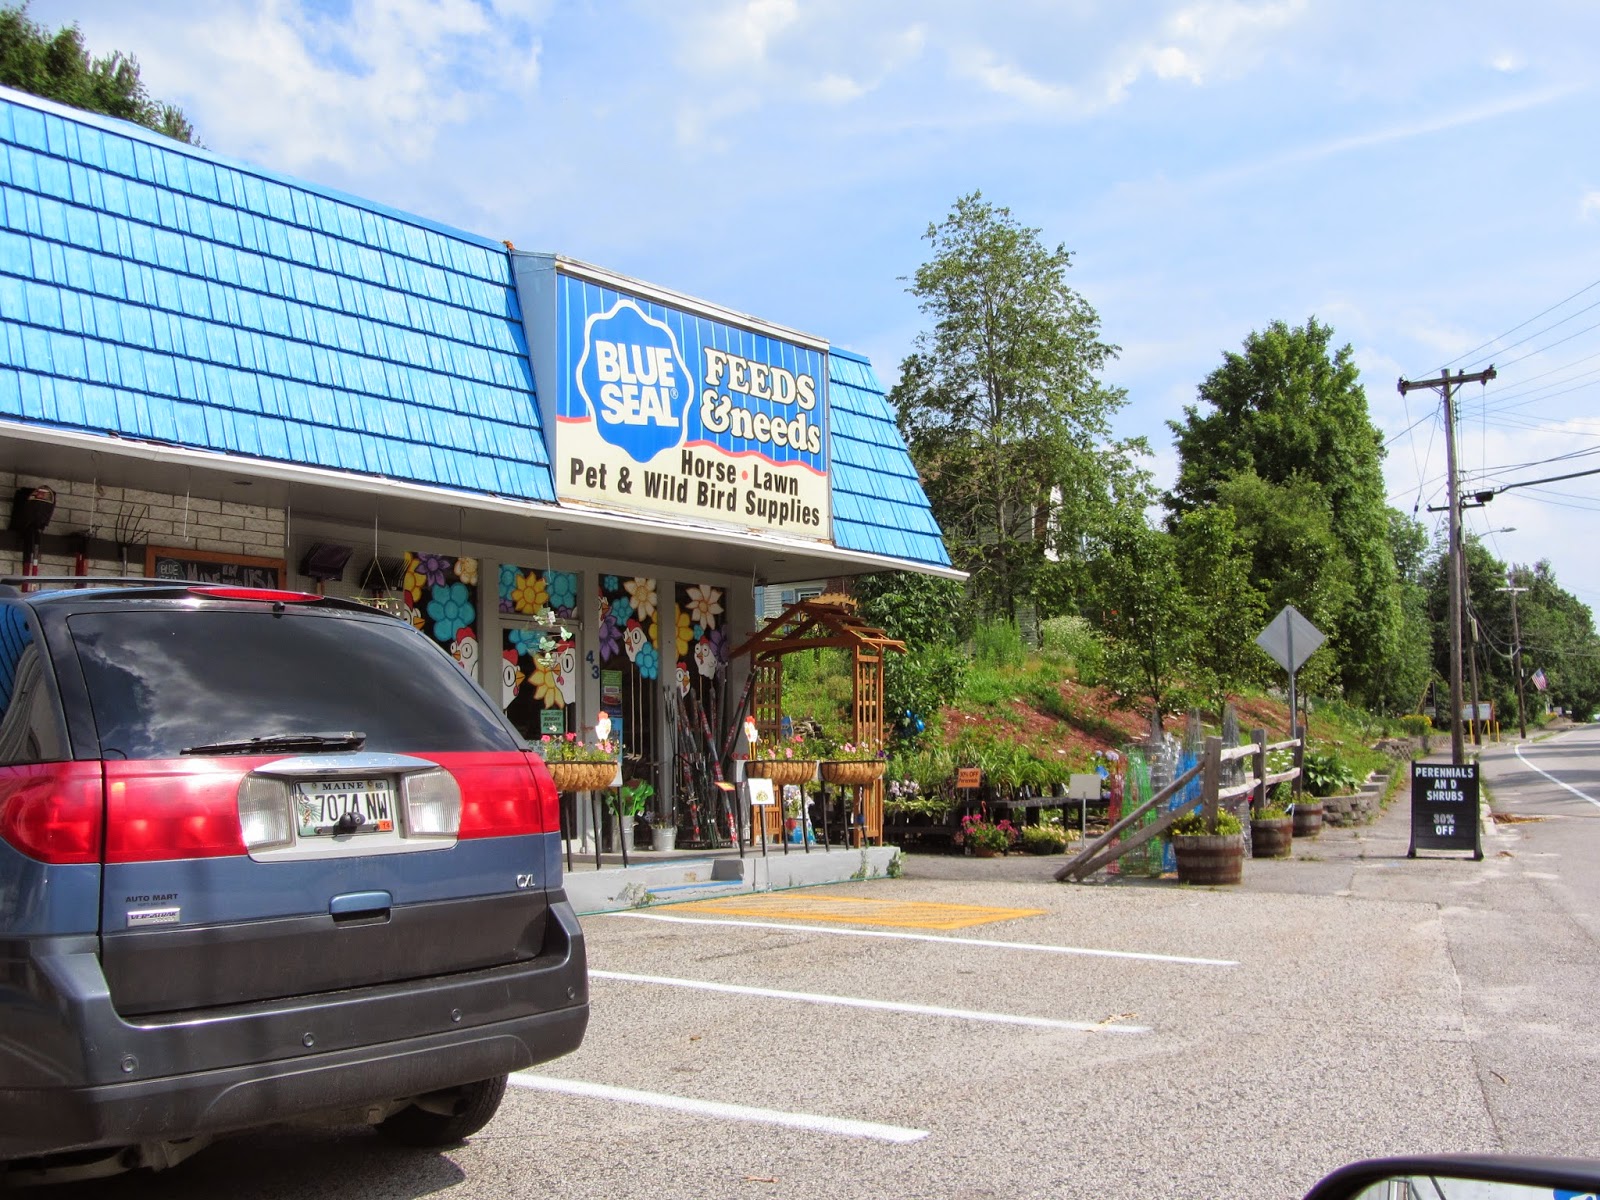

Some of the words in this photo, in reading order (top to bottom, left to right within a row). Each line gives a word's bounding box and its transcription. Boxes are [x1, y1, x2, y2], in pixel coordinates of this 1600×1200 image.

[595, 340, 676, 387] BLUE
[704, 346, 816, 410] FEEDS
[681, 449, 737, 483] Horse
[753, 464, 798, 497] Lawn
[570, 457, 607, 490] Pet
[617, 466, 633, 494] &
[644, 470, 687, 504] Wild
[697, 480, 737, 512] Bird
[745, 490, 820, 527] Supplies
[1416, 767, 1474, 778] PERENNIALS
[322, 782, 364, 790] MAINE
[1426, 791, 1464, 801] SHRUBS
[366, 792, 388, 820] NW
[1436, 825, 1454, 836] OFF
[126, 895, 150, 903] AUTO
